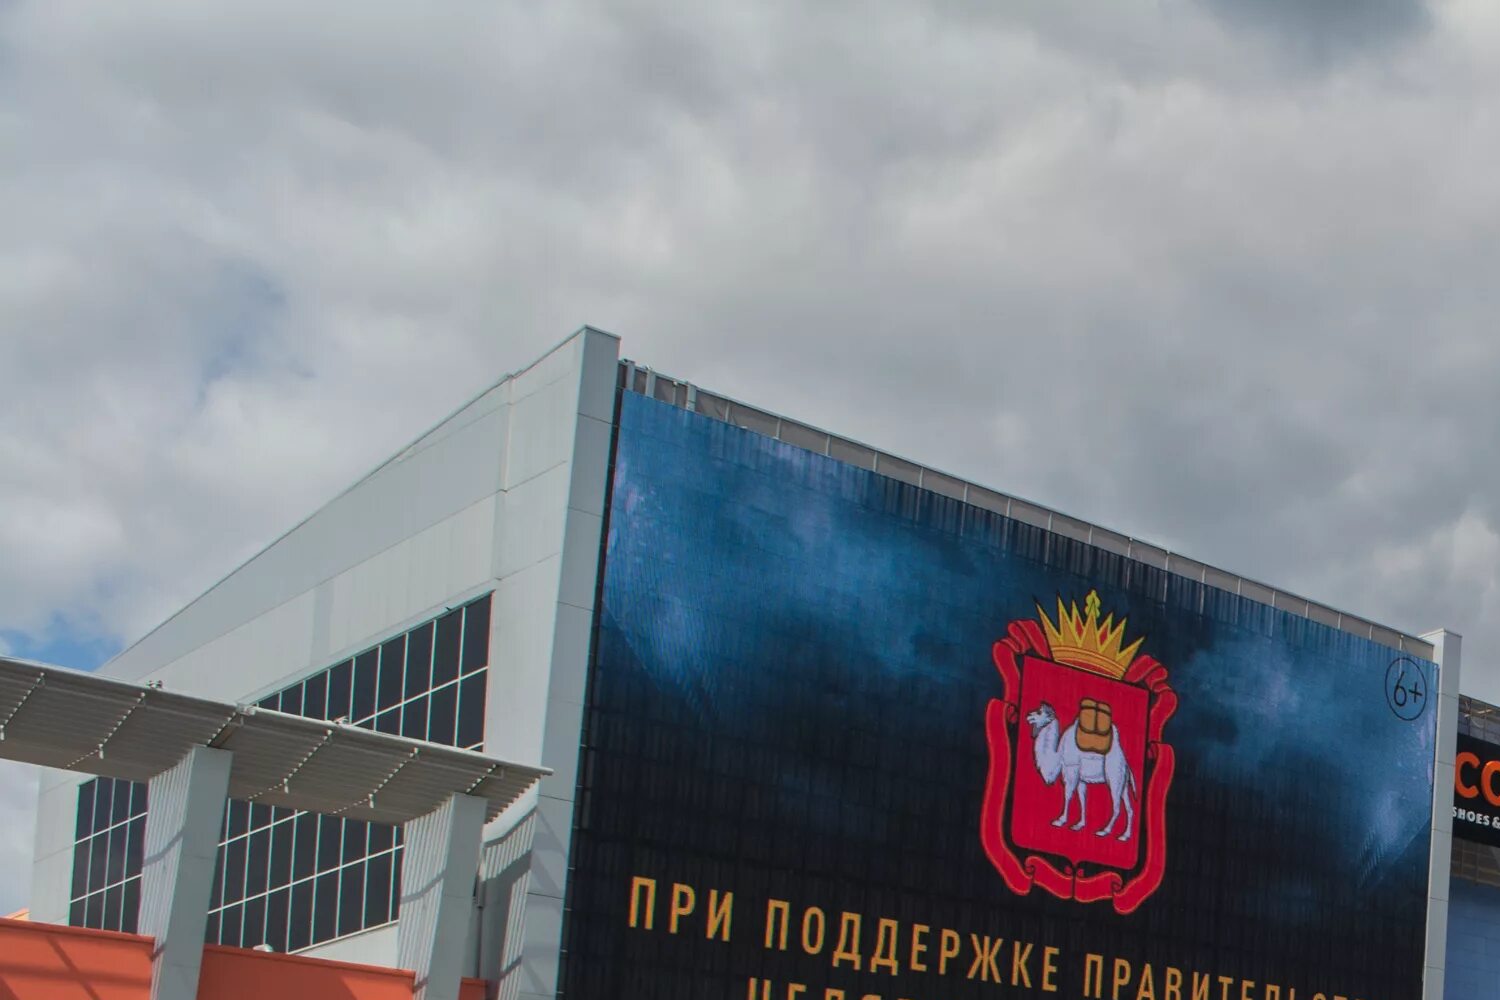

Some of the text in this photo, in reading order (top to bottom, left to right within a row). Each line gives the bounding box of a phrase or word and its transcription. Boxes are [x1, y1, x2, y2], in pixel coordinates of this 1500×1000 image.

[1394, 671, 1422, 707] 6+
[1452, 806, 1490, 826] SHOES
[628, 876, 733, 942] ПРИ
[764, 898, 1060, 992] ПОДДЕРЖКЕ
